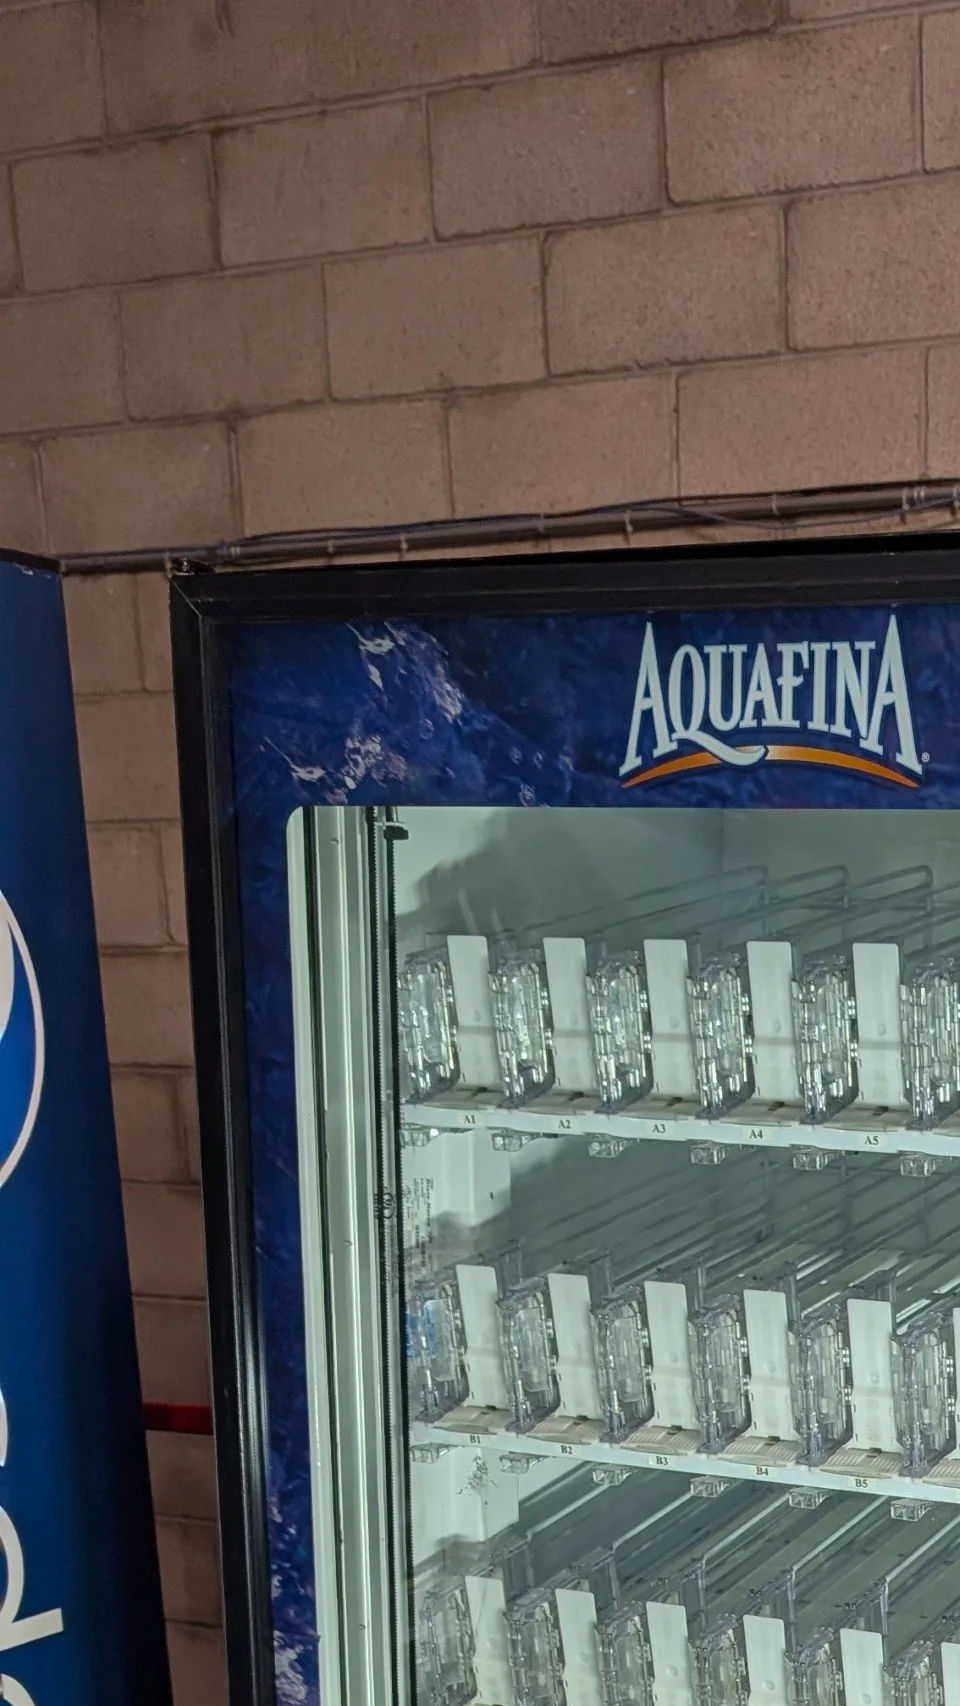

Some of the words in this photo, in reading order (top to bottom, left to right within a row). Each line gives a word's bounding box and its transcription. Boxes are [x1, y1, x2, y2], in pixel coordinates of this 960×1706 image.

[619, 614, 923, 775] AQUAFINA
[463, 1115, 476, 1124] A1
[558, 1119, 572, 1130] A2
[652, 1123, 667, 1134] A3
[749, 1128, 764, 1140] A4
[864, 1135, 880, 1146] A5
[469, 1434, 482, 1445] B1
[560, 1445, 574, 1456] B2
[655, 1455, 669, 1466] B3
[755, 1465, 769, 1476] B4
[854, 1478, 869, 1489] B5
